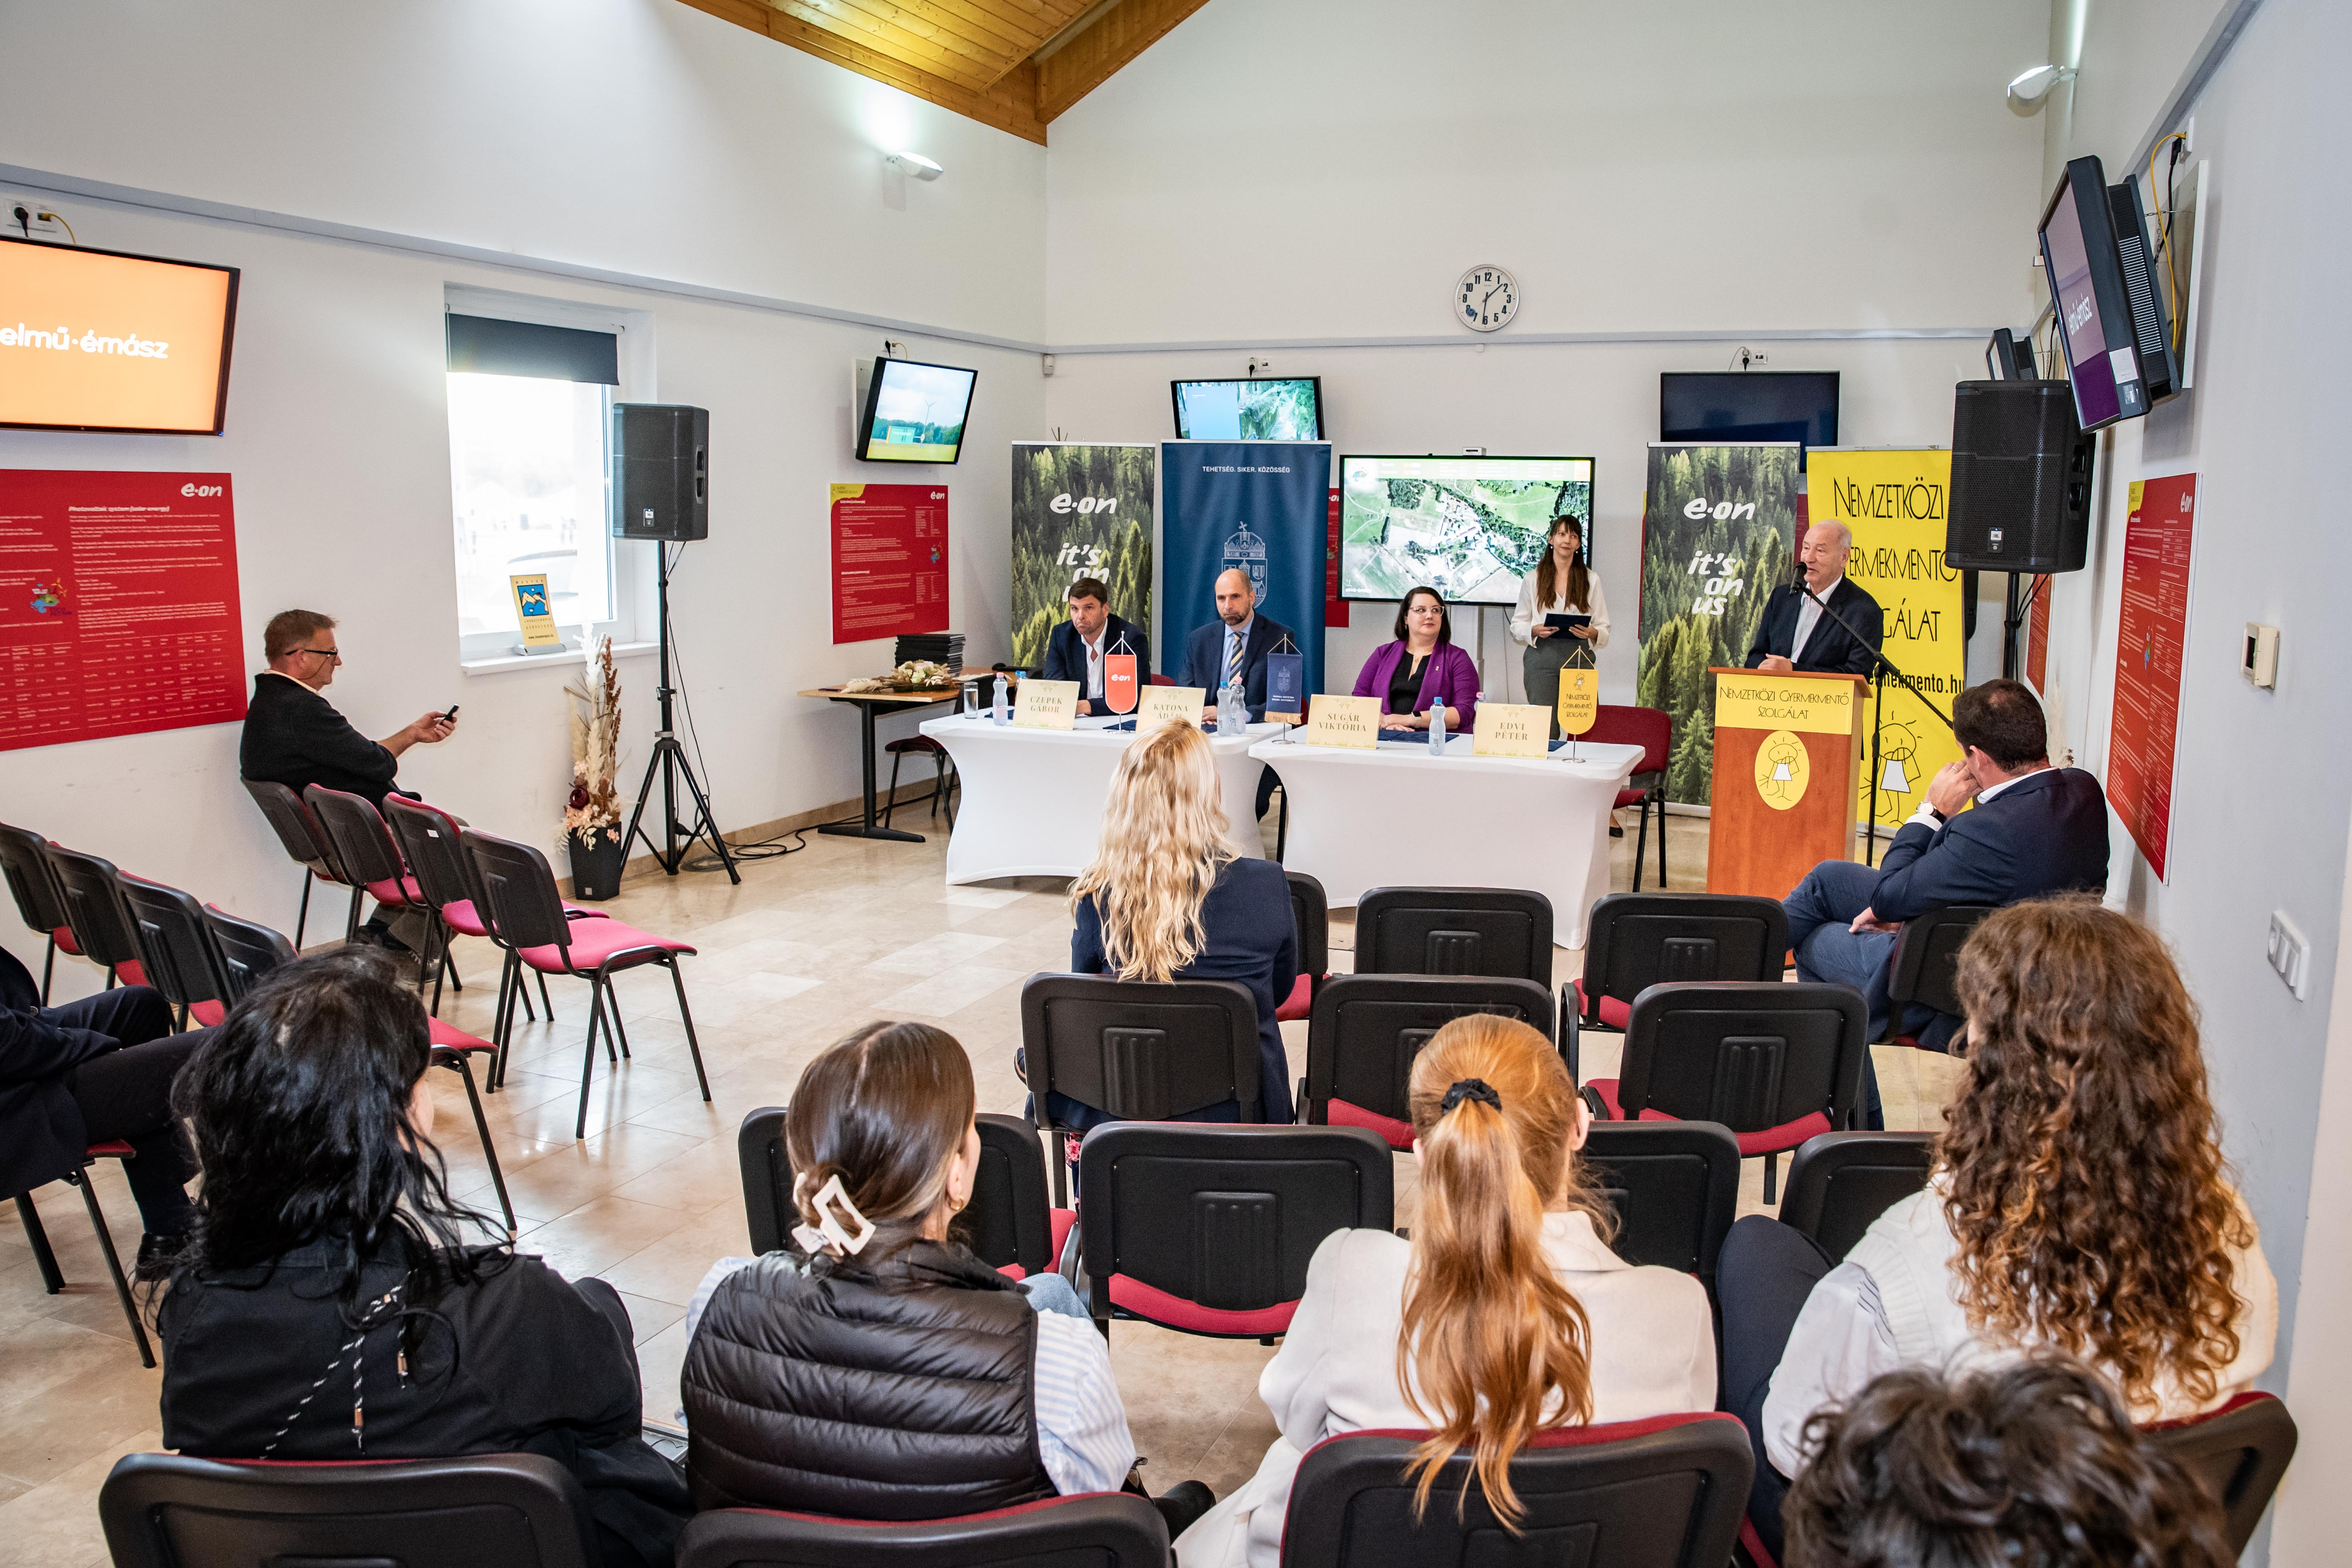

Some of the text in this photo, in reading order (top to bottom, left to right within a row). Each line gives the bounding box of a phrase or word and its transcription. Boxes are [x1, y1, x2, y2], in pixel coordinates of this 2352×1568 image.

[1475, 275, 1481, 284] 11
[1484, 272, 1492, 281] 12
[1497, 275, 1500, 284] 1
[1466, 283, 1473, 292] 10
[1503, 283, 1508, 292] 2
[1463, 294, 1467, 303] 9
[1507, 294, 1511, 303] 3
[1502, 305, 1507, 314] 4
[1473, 313, 1478, 322] 7
[1483, 315, 1488, 325] 6
[1494, 313, 1499, 322] 5
[1834, 476, 1944, 519] NEMZETKÖZI
[1844, 547, 1957, 582] ERMEKMENT
[1073, 567, 1110, 584] on
[1704, 578, 1744, 596] on
[1692, 597, 1728, 615] us
[1882, 598, 1941, 641] GÁLAT
[1720, 686, 1849, 705] NEMZETKÖZI GYERMEKMENTŐ
[1031, 704, 1059, 713] GÁBOR
[1758, 705, 1809, 719] SZOLGÁLAT
[1328, 713, 1359, 721] SUGÁR
[1319, 722, 1366, 731] VIKTÓRIA
[1495, 730, 1528, 740] PÉTER
